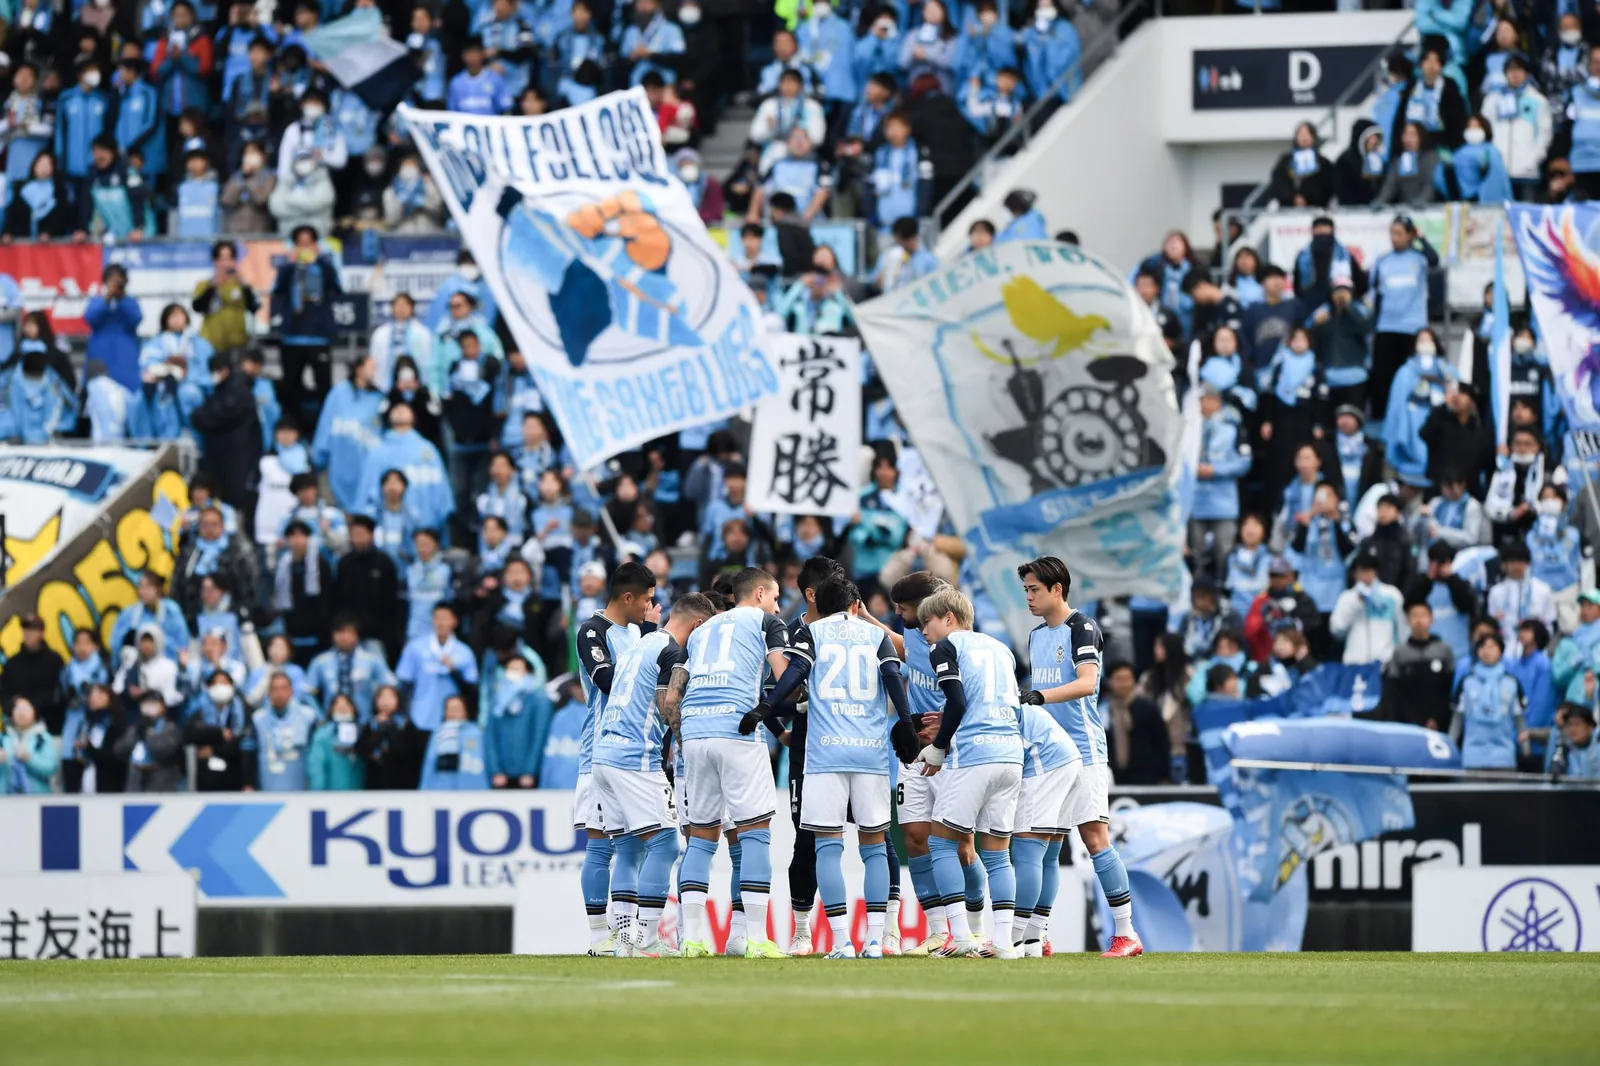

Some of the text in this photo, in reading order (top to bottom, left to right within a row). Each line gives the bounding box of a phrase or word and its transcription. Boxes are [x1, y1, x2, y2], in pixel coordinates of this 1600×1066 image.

[1288, 51, 1321, 91] D
[767, 341, 851, 508] 常勝
[690, 622, 736, 674] 11
[818, 644, 878, 700] 20
[908, 667, 940, 691] MAH
[686, 705, 737, 716] SAKURA
[831, 703, 866, 717] RYOGA
[830, 736, 882, 748] SAKURA
[896, 782, 905, 806] 6
